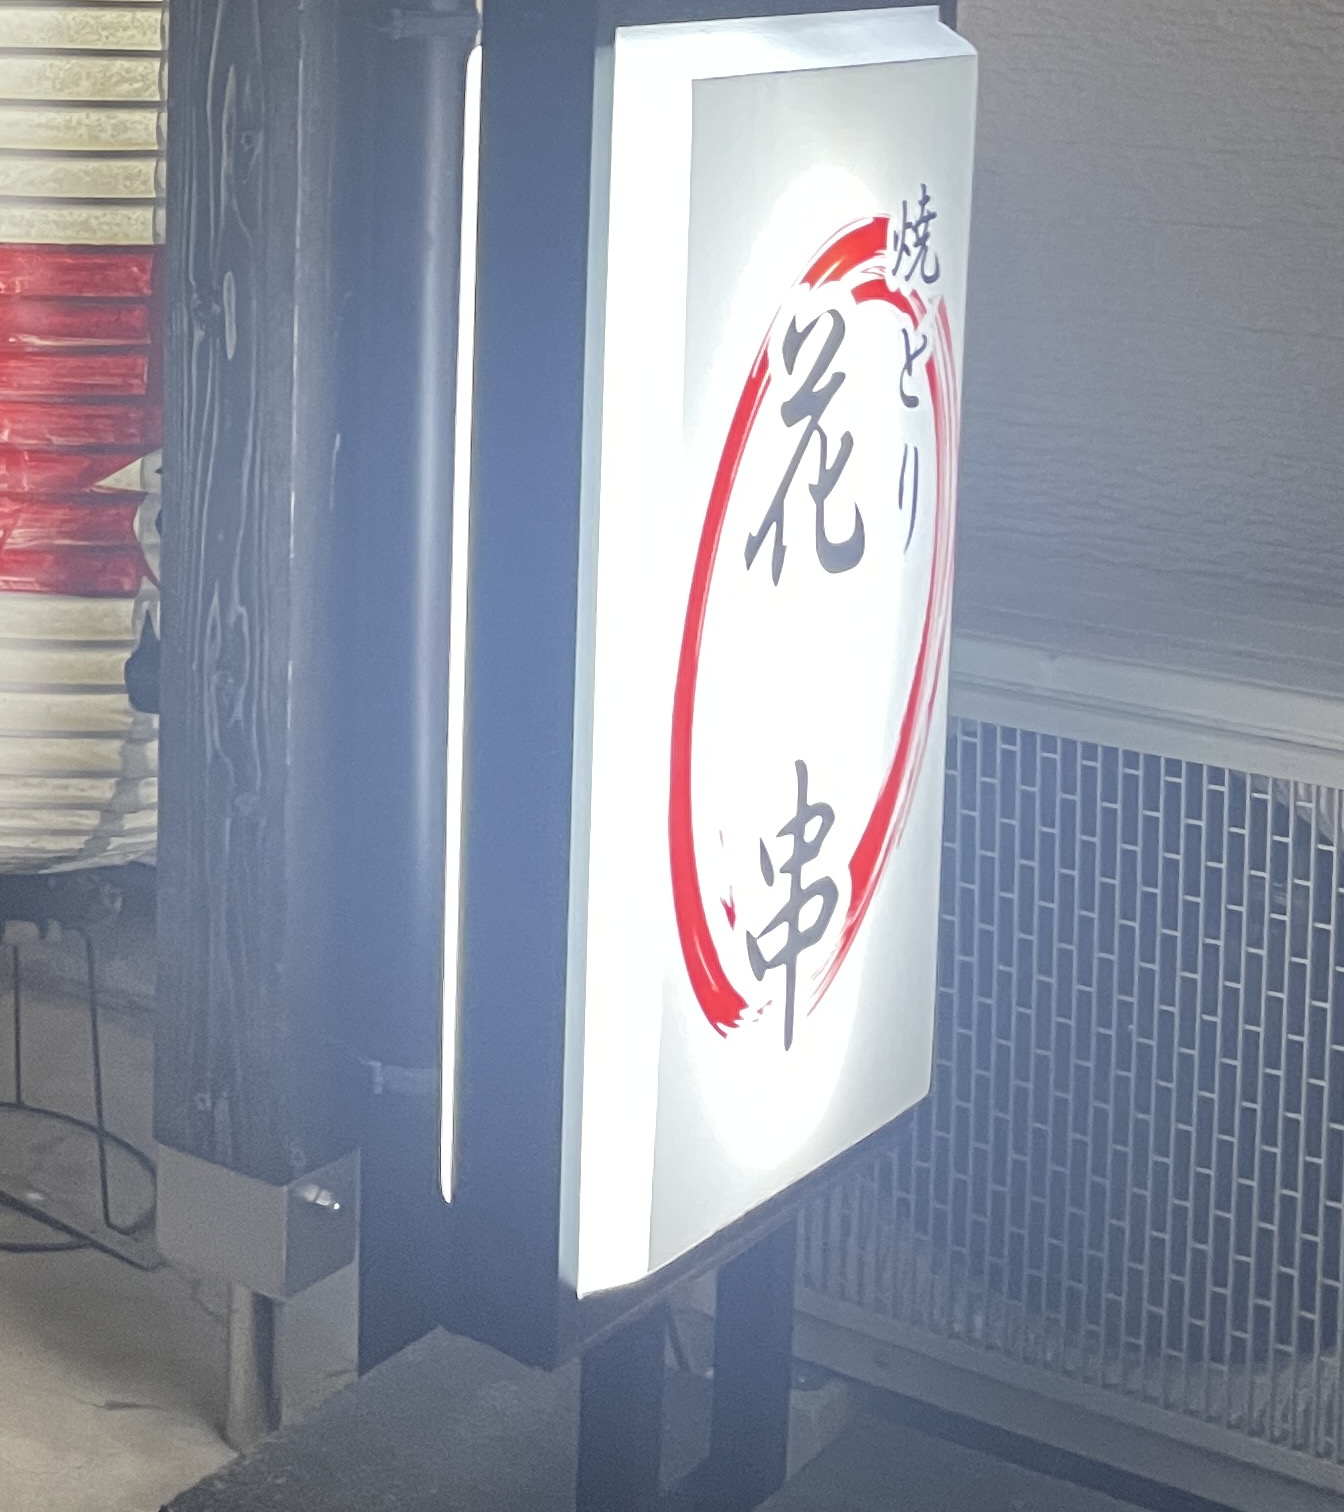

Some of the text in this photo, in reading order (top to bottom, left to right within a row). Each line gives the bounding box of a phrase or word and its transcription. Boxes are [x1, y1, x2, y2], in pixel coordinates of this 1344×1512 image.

[892, 183, 940, 555] 焼とり
[745, 308, 866, 1052] 花串
